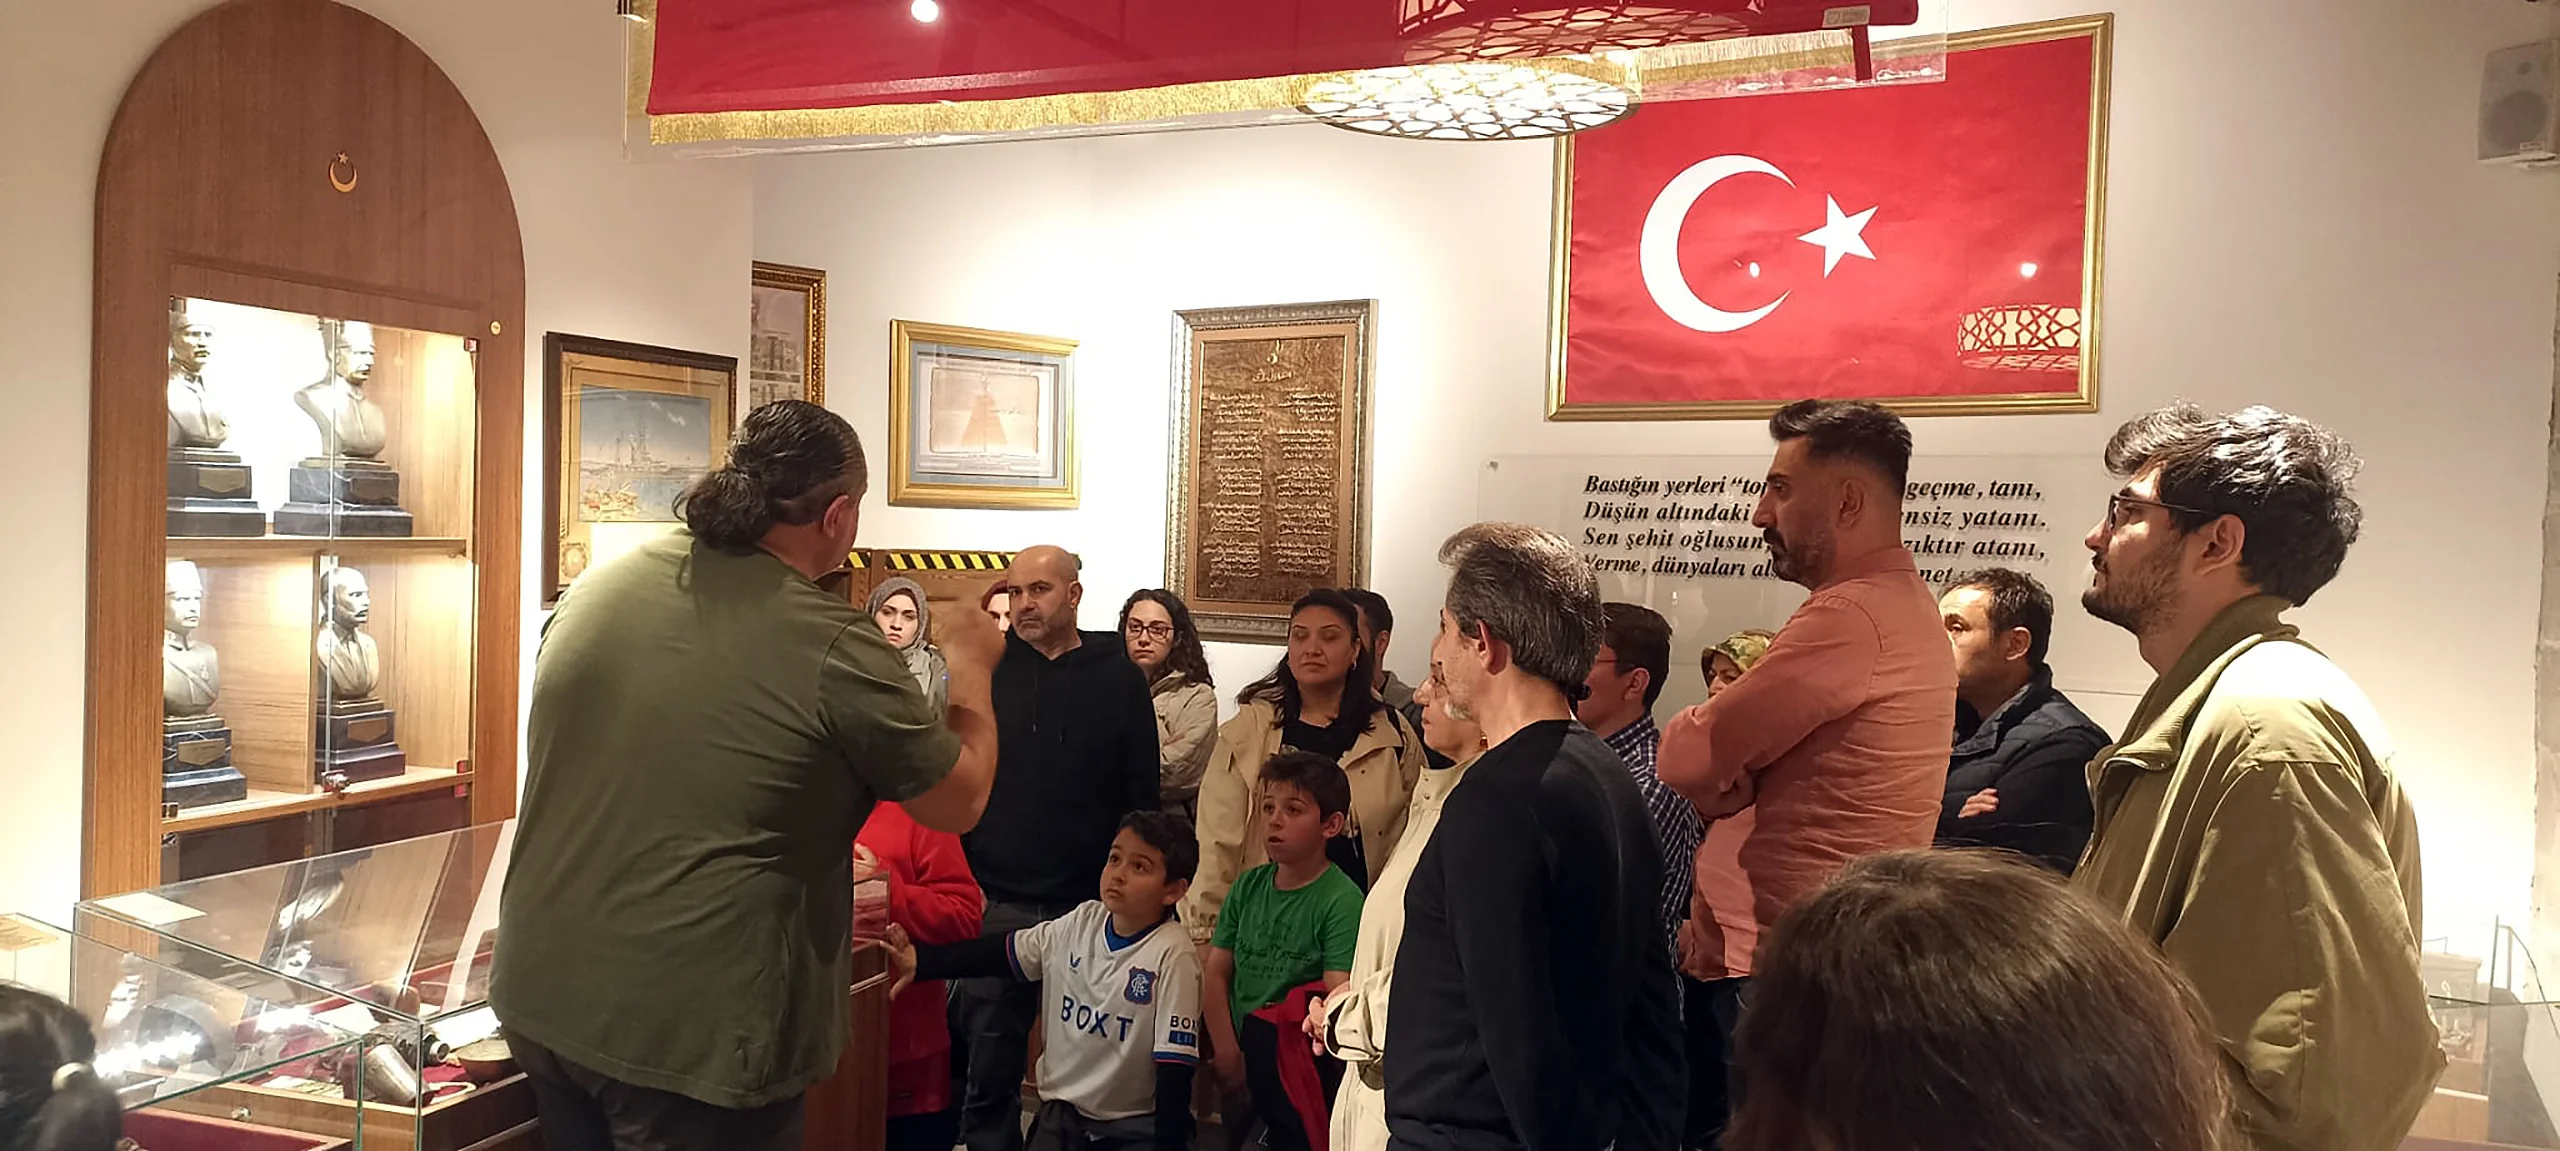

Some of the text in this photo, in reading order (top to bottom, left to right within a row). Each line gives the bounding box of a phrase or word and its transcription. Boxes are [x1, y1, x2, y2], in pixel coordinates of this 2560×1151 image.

[1584, 475, 1660, 497] Bastığın
[1664, 476, 1727, 499] yerleri
[1905, 482, 1983, 501] geçme,
[1989, 480, 2042, 499] tanı,
[1584, 501, 2047, 530] Düşün altındaki nsiz yatanı.
[1583, 527, 2045, 560] Sen şehit oğlusun, zıktır atanı,
[1652, 555, 1746, 579] dünyaları
[1061, 995, 1134, 1042] BOXT
